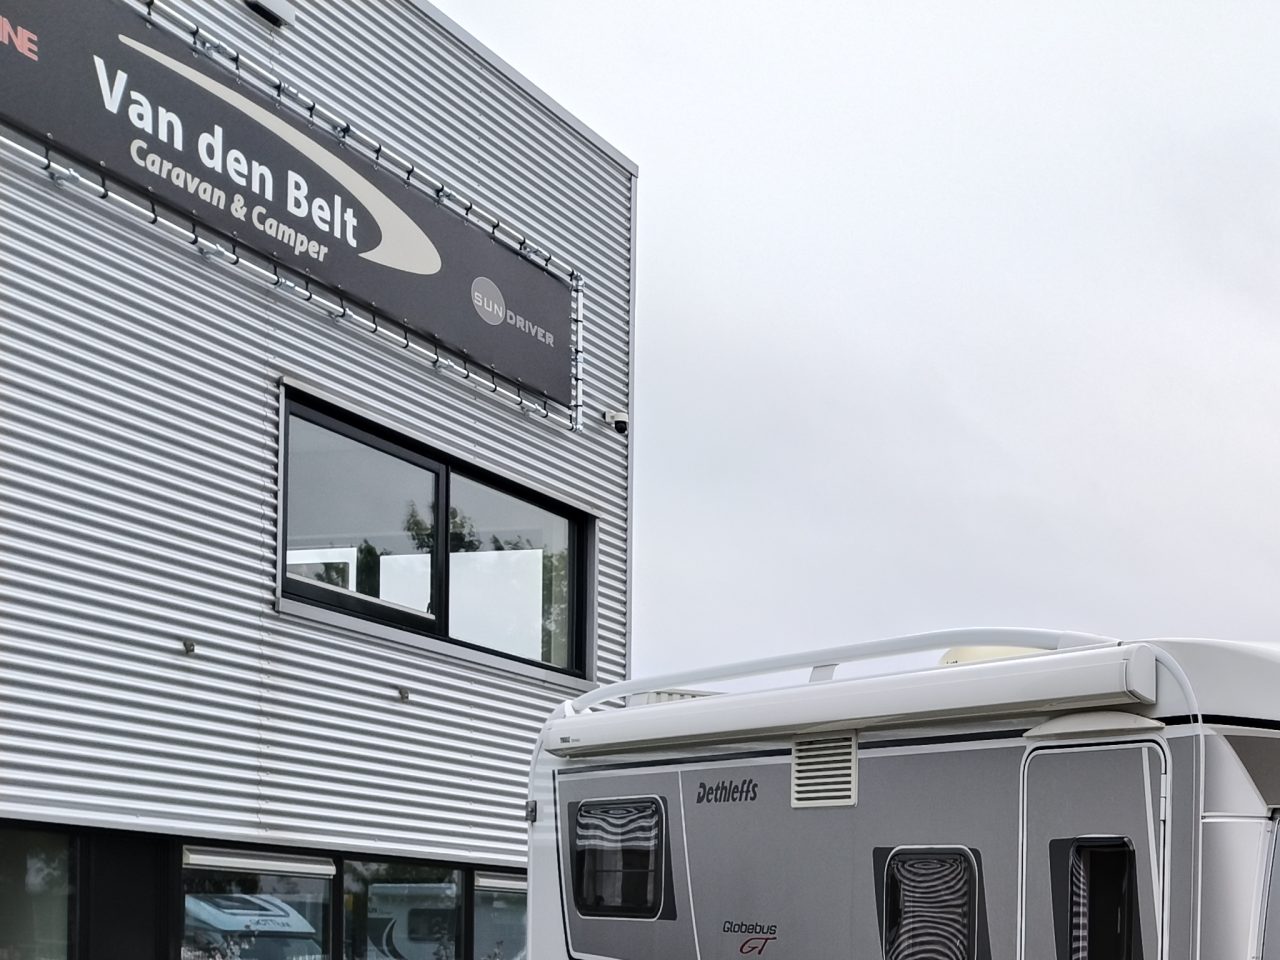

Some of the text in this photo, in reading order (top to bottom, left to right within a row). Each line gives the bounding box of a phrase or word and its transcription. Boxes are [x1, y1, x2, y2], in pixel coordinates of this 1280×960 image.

[93, 54, 358, 248] Van den Belt
[130, 138, 329, 262] Caravan & Camper
[474, 291, 554, 347] SUN DRIVER
[696, 778, 758, 804] Dethleffs
[722, 920, 777, 935] Globebus
[739, 937, 777, 955] GT
